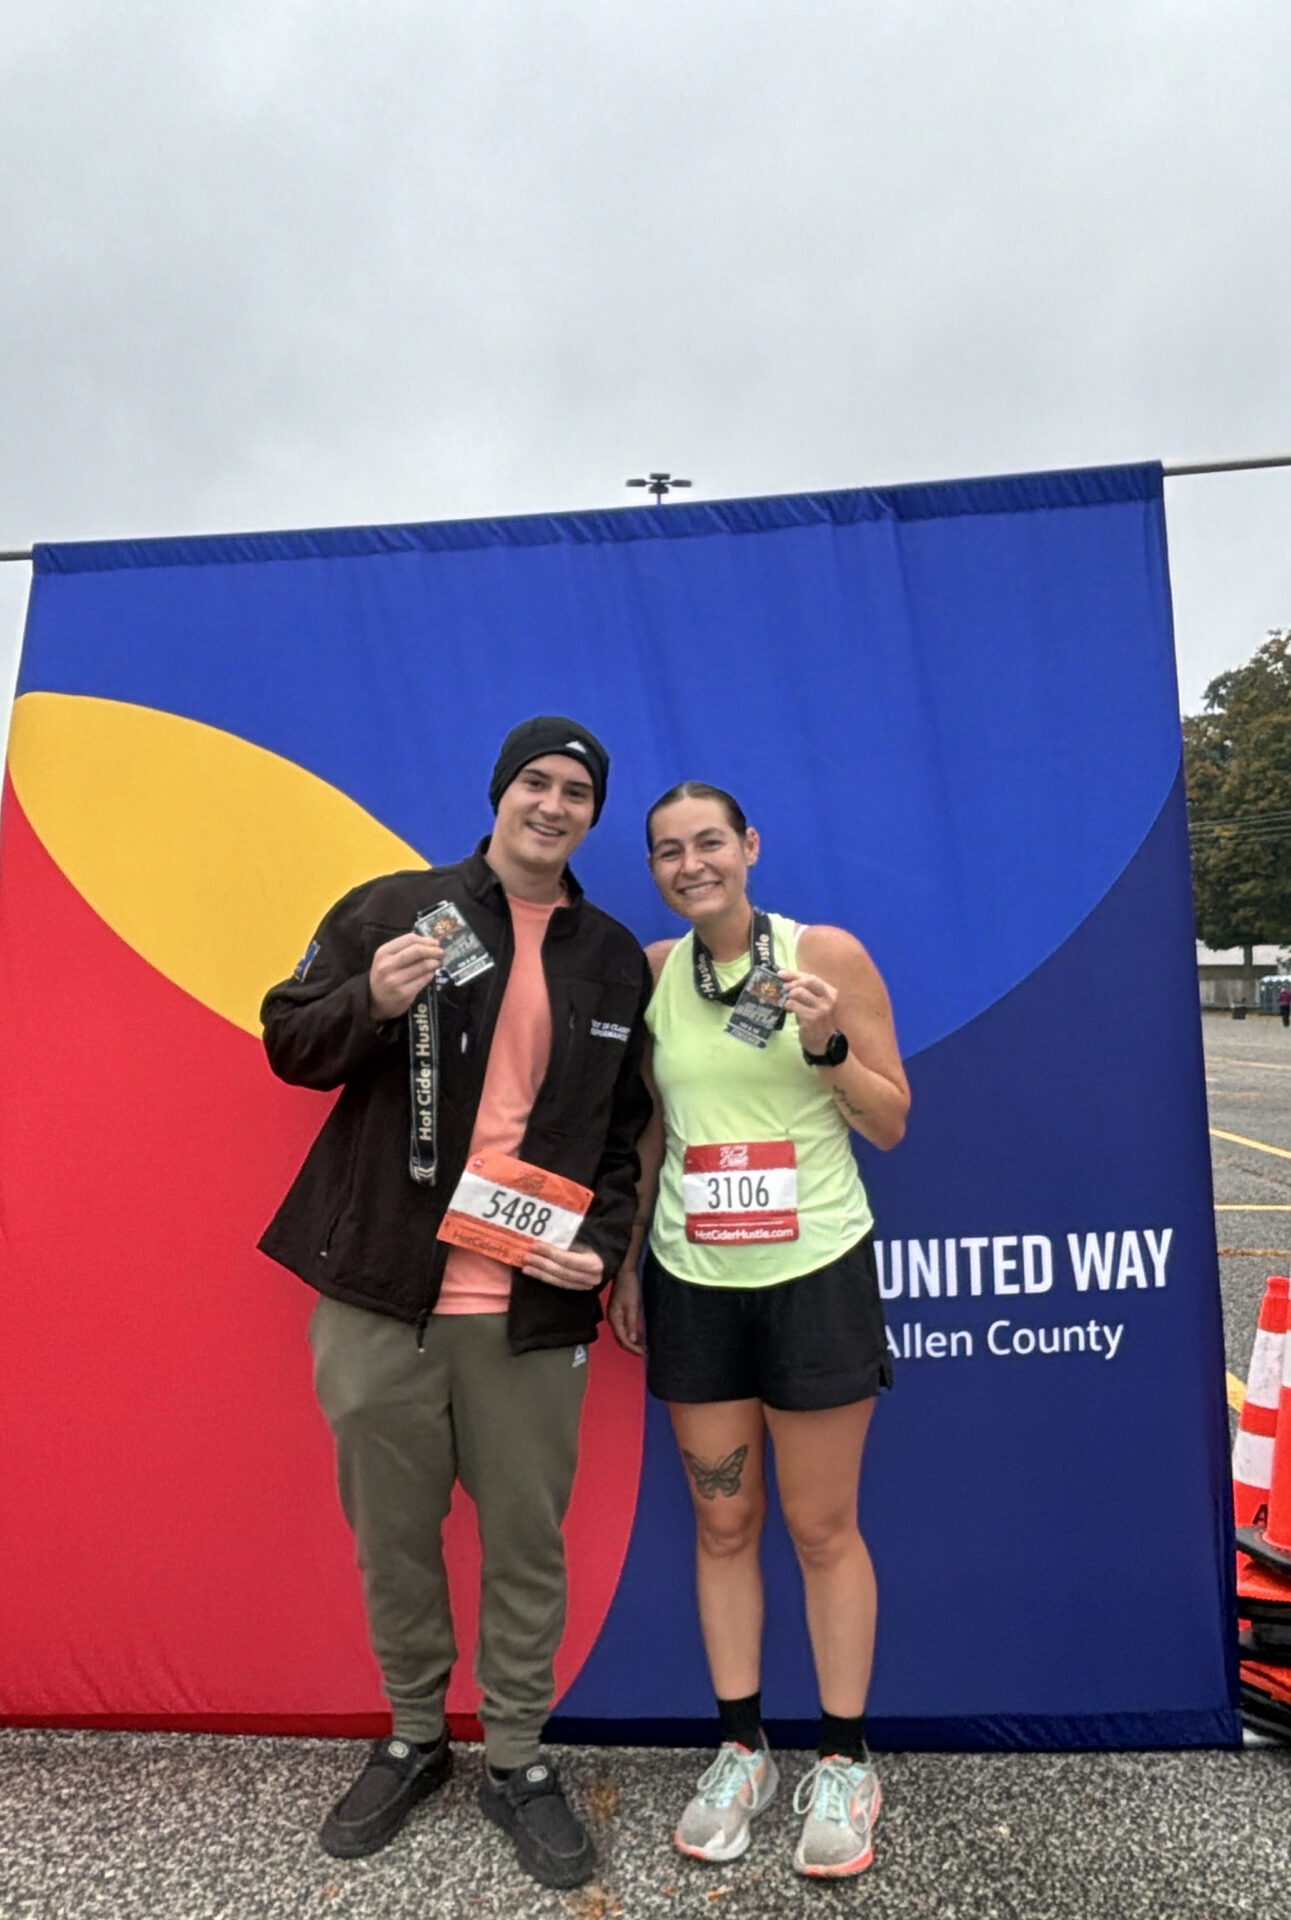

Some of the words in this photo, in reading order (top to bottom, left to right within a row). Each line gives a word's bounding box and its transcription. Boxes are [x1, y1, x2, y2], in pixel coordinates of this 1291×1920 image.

[413, 1003, 430, 1057] Hustle
[416, 1062, 432, 1106] Cider
[419, 1109, 432, 1141] Hot
[482, 1189, 552, 1236] 5488
[707, 1175, 769, 1209] 3106
[694, 1228, 794, 1240] HotCiderHustle.com
[873, 1234, 1054, 1299] UNITED
[1067, 1228, 1173, 1292] WAY
[884, 1322, 973, 1359] Allen
[987, 1319, 1124, 1360] County
